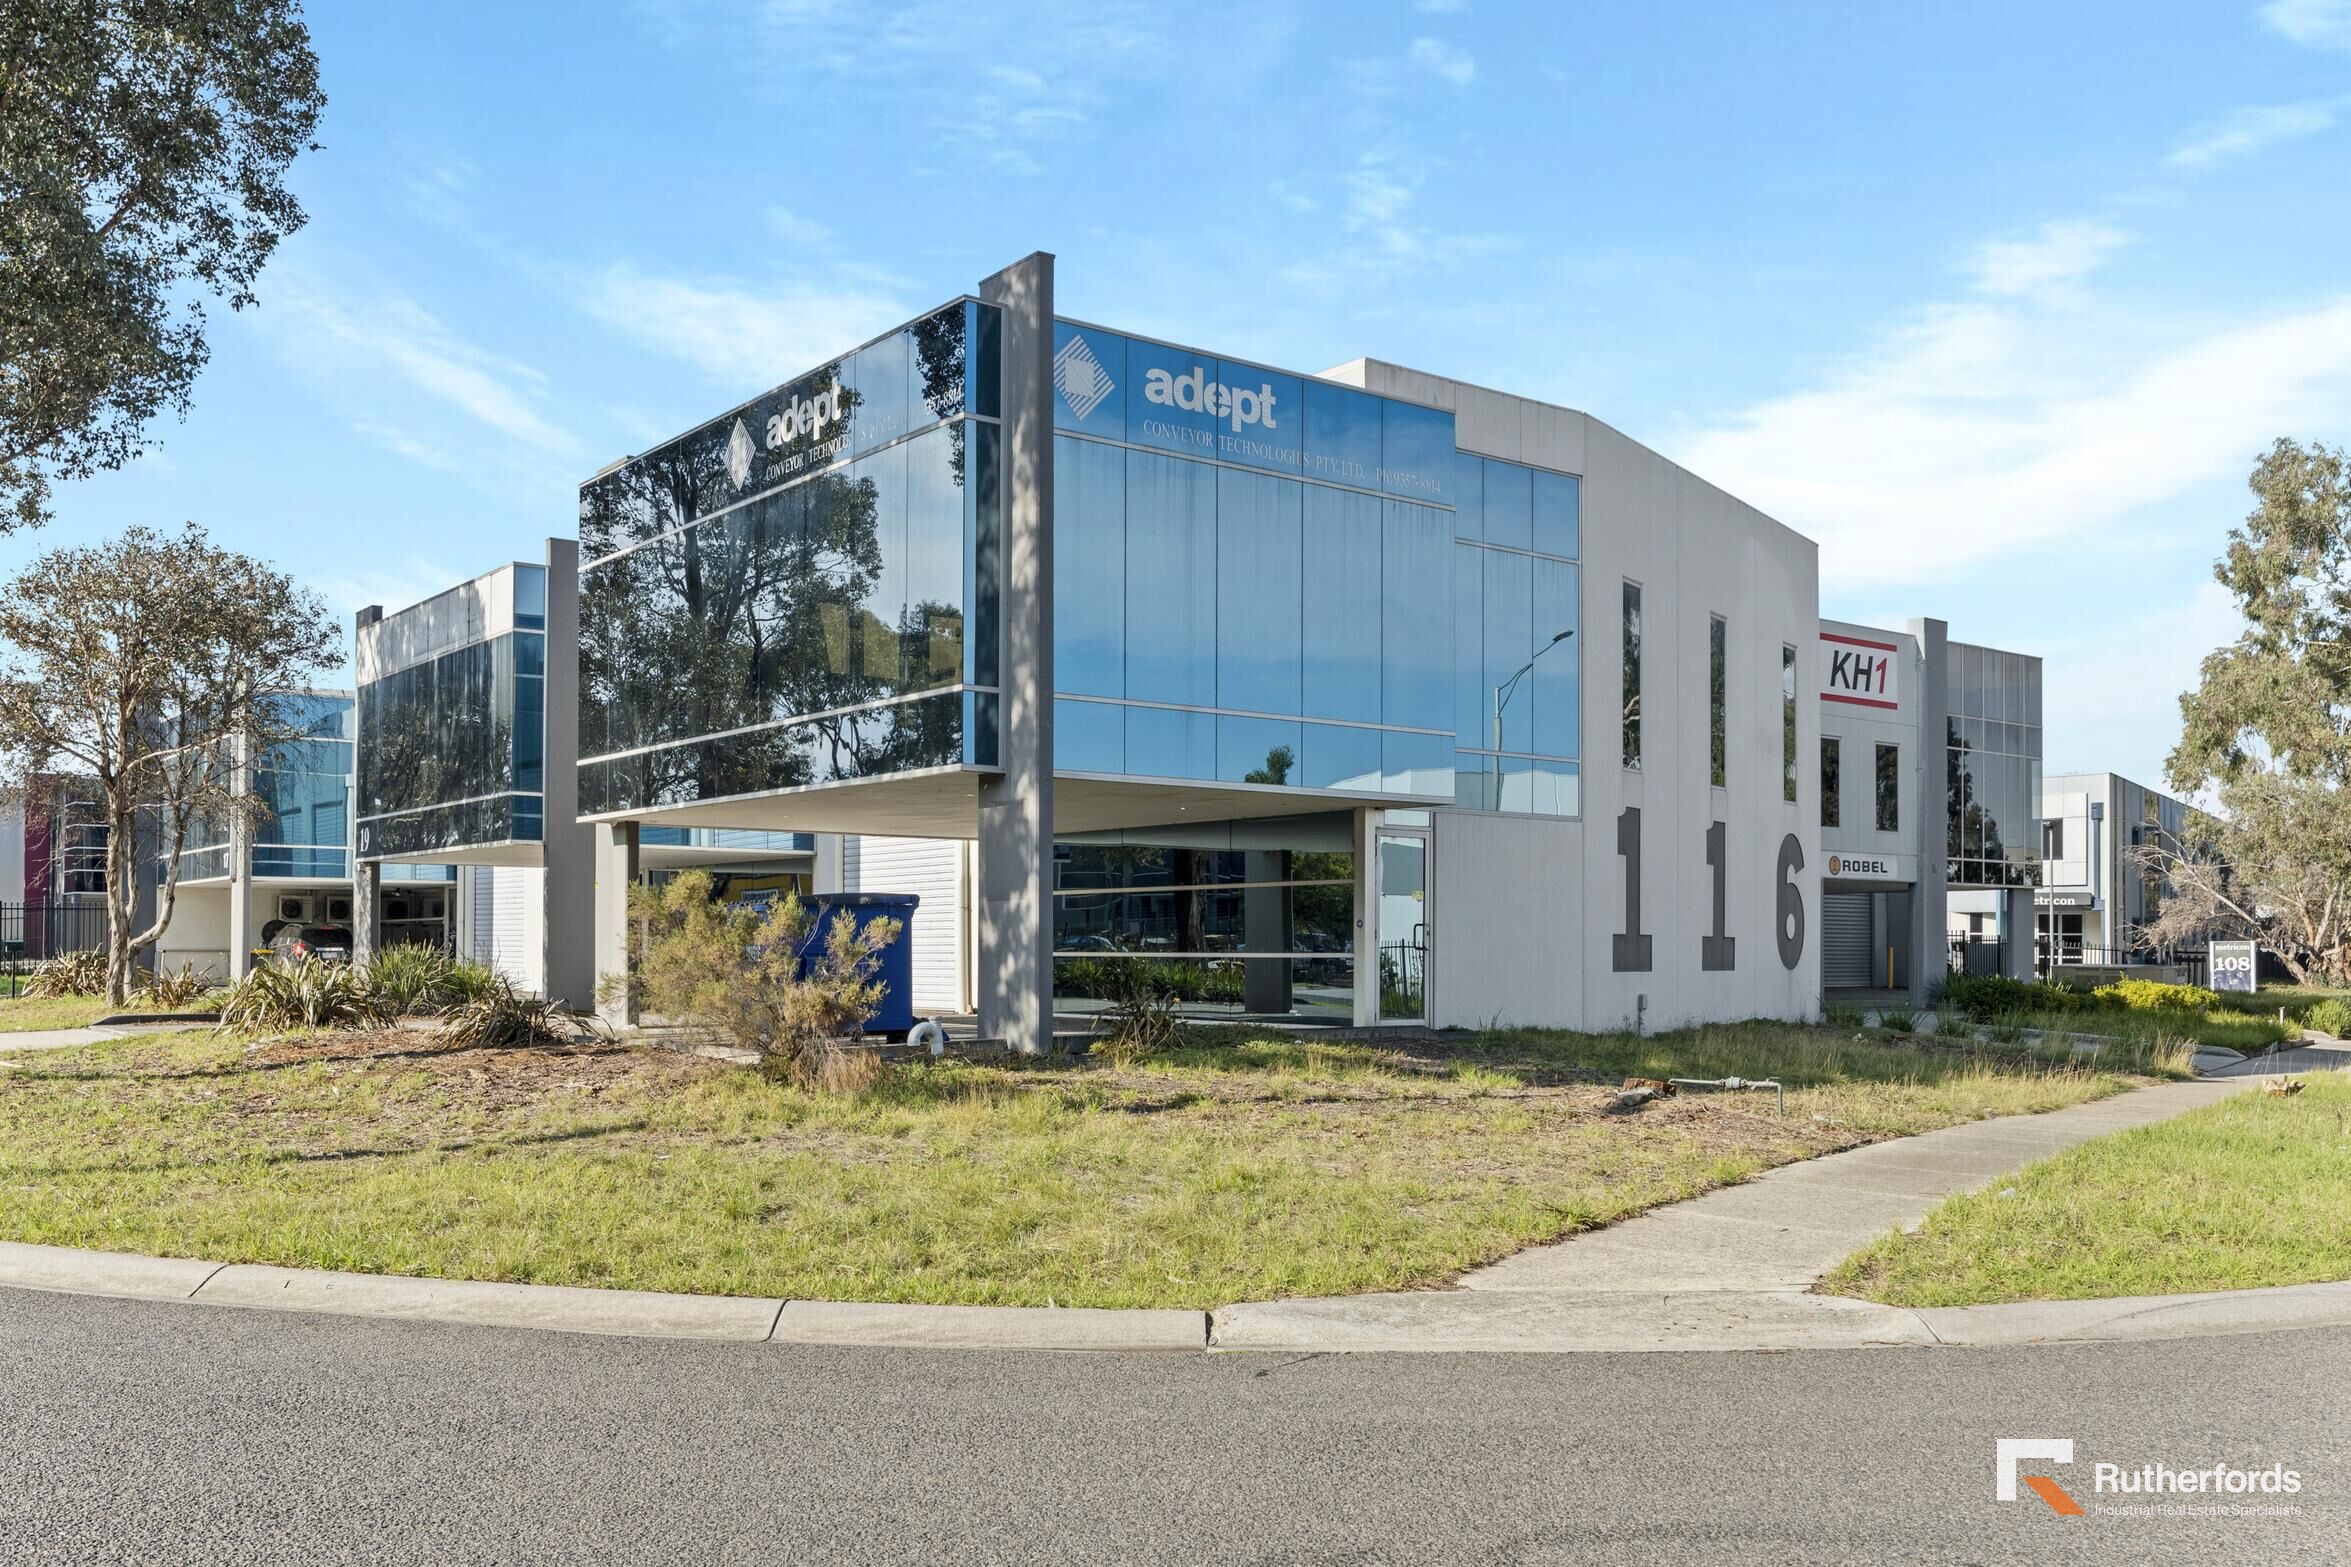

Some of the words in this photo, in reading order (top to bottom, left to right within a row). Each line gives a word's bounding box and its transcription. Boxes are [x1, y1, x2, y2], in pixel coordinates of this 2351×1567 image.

[766, 377, 841, 450] adept
[1144, 366, 1277, 433] adept
[1143, 419, 1213, 448] CONVEYOR
[1219, 434, 1310, 468] TECHNOLOGIES
[766, 453, 804, 481] CONVEYOR
[1830, 649, 1887, 694] KH1
[360, 827, 370, 852] 19
[1842, 860, 1888, 873] ROBEL
[1613, 806, 1805, 971] 116
[2034, 897, 2076, 905] etrcon
[2214, 957, 2251, 971] 108
